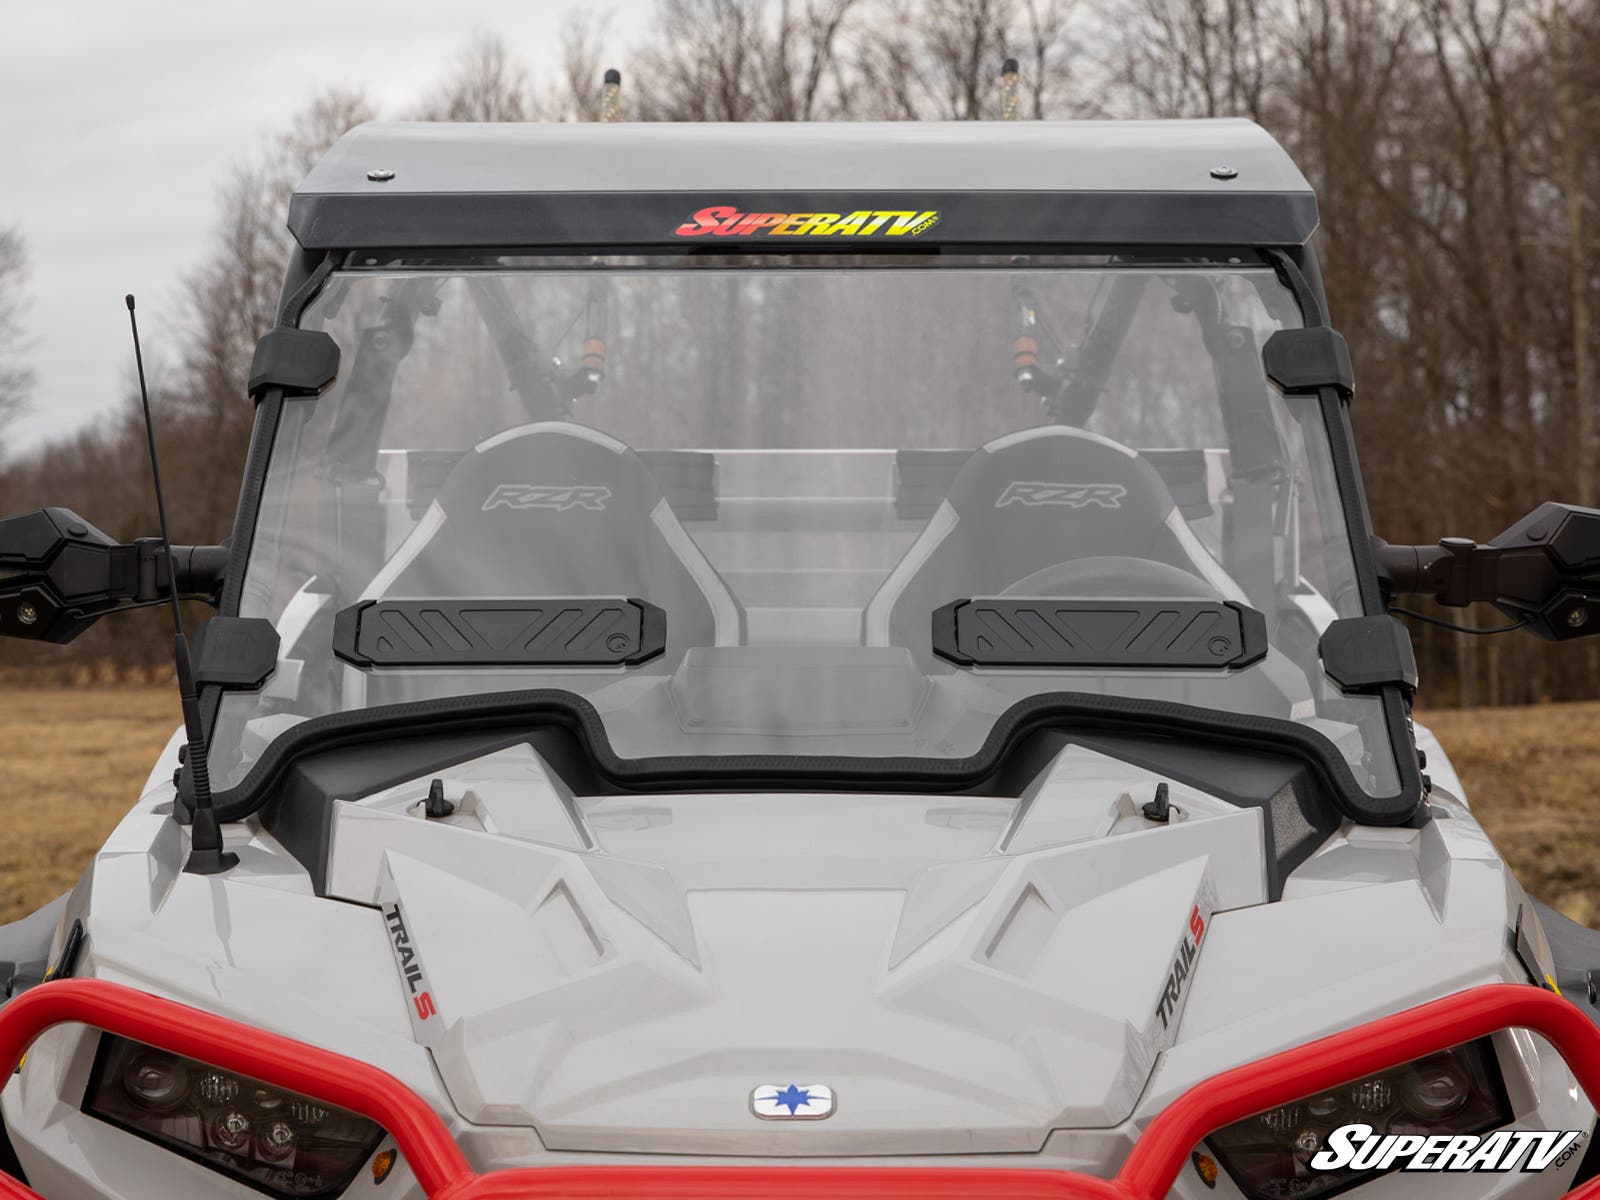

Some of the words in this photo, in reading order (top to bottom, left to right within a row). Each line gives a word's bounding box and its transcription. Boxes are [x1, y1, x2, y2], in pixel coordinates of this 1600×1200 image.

[675, 206, 937, 236] SUPERATV
[481, 484, 612, 511] RZR
[995, 481, 1128, 508] RZR
[386, 903, 422, 994] TRAIL
[413, 991, 437, 1020] S
[1155, 936, 1196, 1031] TRAIL
[1189, 904, 1204, 946] S
